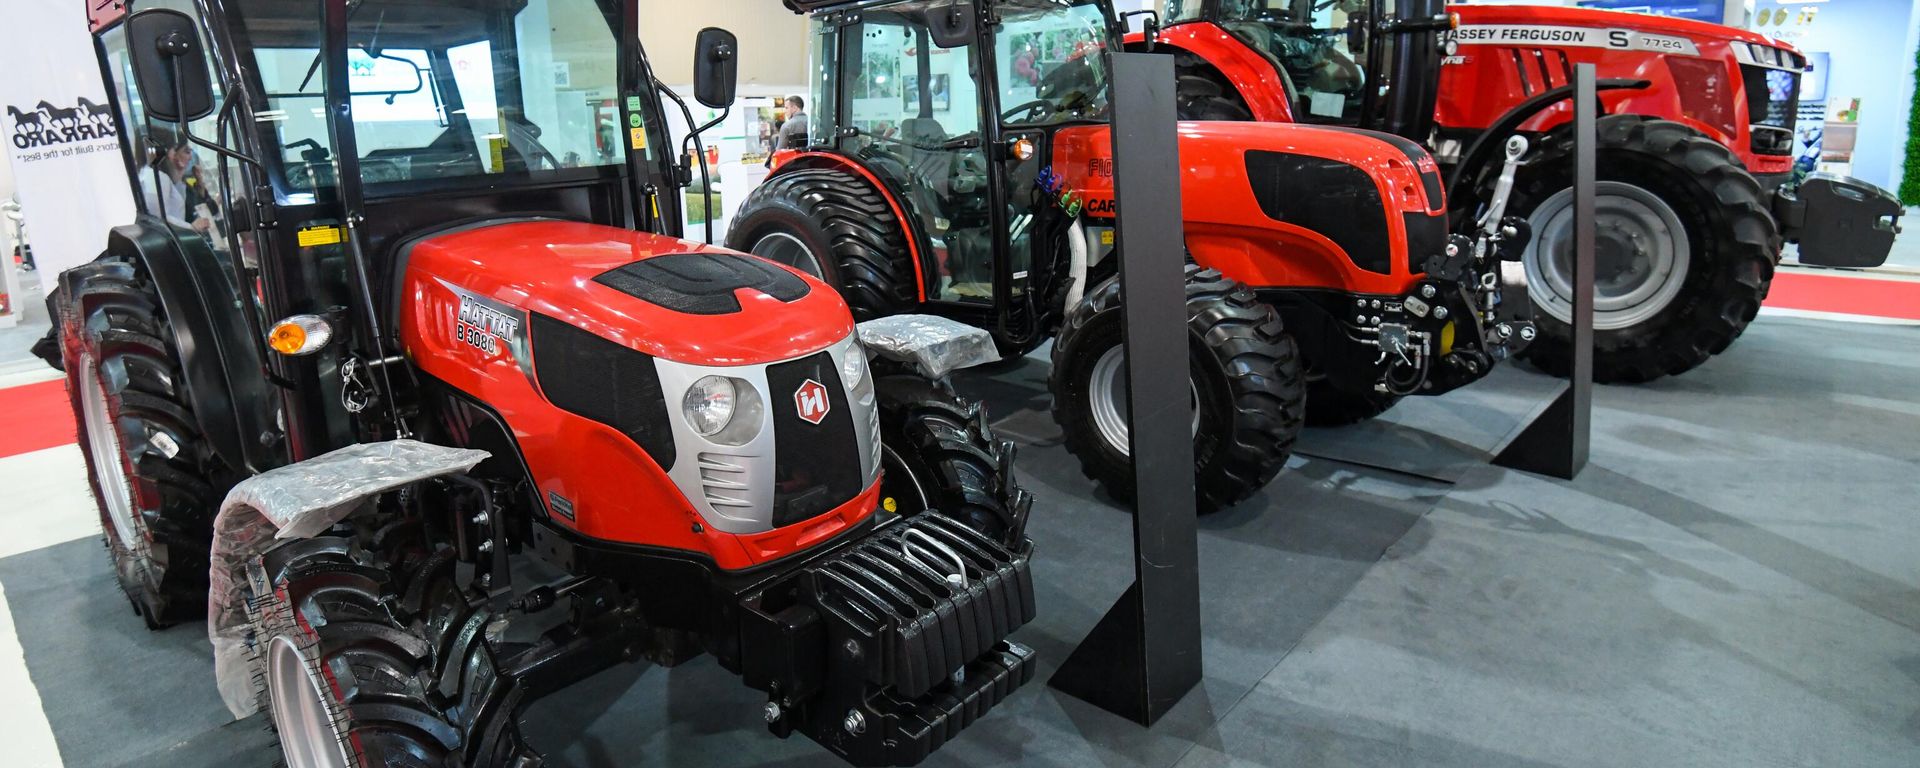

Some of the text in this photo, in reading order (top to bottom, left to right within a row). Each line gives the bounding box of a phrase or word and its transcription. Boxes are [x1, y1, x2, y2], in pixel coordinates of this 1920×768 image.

[1501, 29, 1586, 42] FERGUSON
[1609, 30, 1629, 48] S
[1642, 38, 1682, 49] 7724
[458, 294, 518, 343] HATTAT
[457, 323, 495, 354] B 3080
